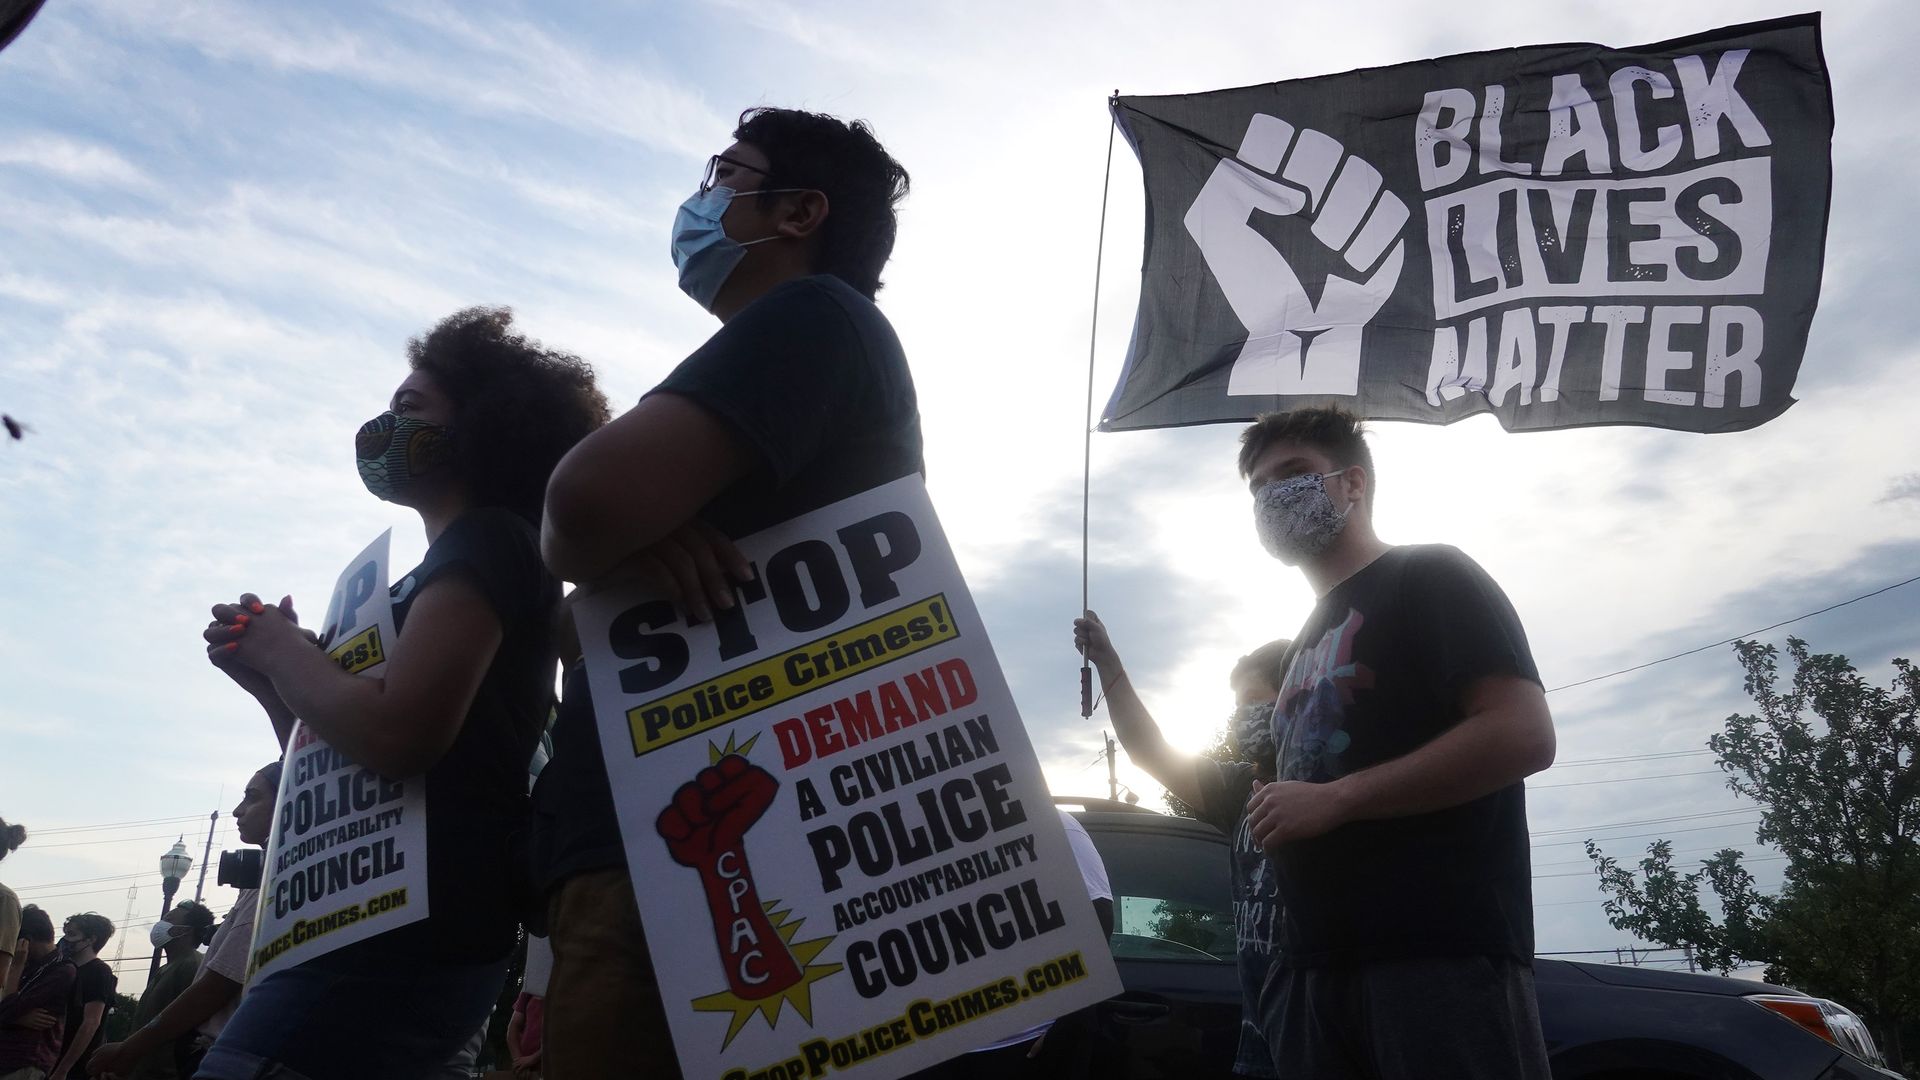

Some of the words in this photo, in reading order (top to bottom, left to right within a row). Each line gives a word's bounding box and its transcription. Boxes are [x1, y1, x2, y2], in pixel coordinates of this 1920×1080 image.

[1416, 49, 1771, 191] BLACK
[1447, 177, 1742, 303] LIVES
[1425, 305, 1764, 408] MATTER
[609, 511, 921, 694] STOP
[641, 674, 775, 742] Police
[784, 602, 950, 688] Crimes!
[772, 657, 978, 770] DEMAND
[278, 768, 404, 849] POLICE
[796, 780, 827, 821] A
[829, 714, 1000, 800] CIVILIAN
[275, 836, 405, 919] COUNCIL
[277, 807, 404, 875] ACCOUNTABILITY
[806, 763, 1028, 894] POLICE
[833, 834, 1039, 932] ACCOUNTABILITY
[717, 851, 770, 984] CPAC
[846, 878, 1066, 998] COUNCIL
